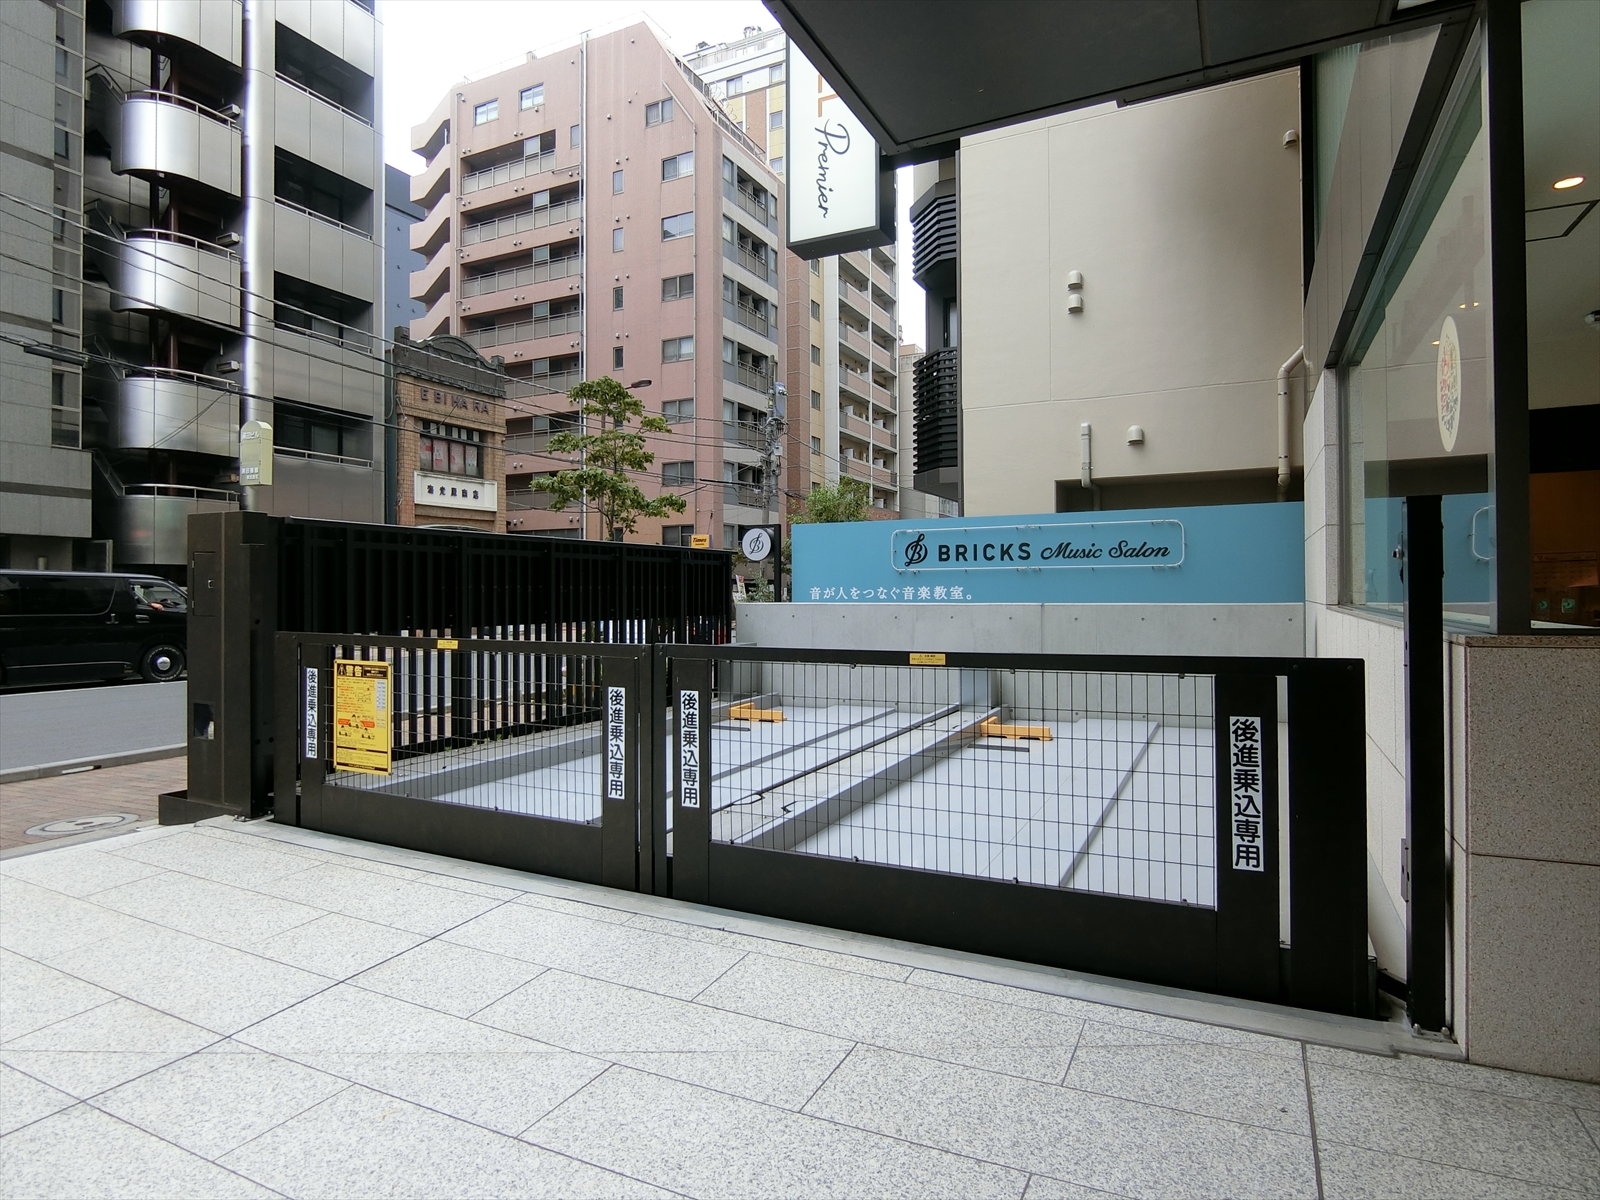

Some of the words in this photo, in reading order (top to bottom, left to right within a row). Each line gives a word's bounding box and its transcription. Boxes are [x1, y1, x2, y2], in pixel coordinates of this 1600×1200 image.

[815, 118, 850, 218] Premier
[809, 586, 972, 600] 音が人をつなぐ音楽教室。
[938, 543, 1031, 562] BRICKS
[1040, 543, 1102, 560] Music
[1108, 540, 1170, 559] Salon
[307, 669, 318, 758] 後進乗込専用
[609, 688, 624, 798] 後進乗込専用
[682, 691, 698, 806] 後進乗込専用
[1232, 718, 1261, 869] 後進乗込専用
